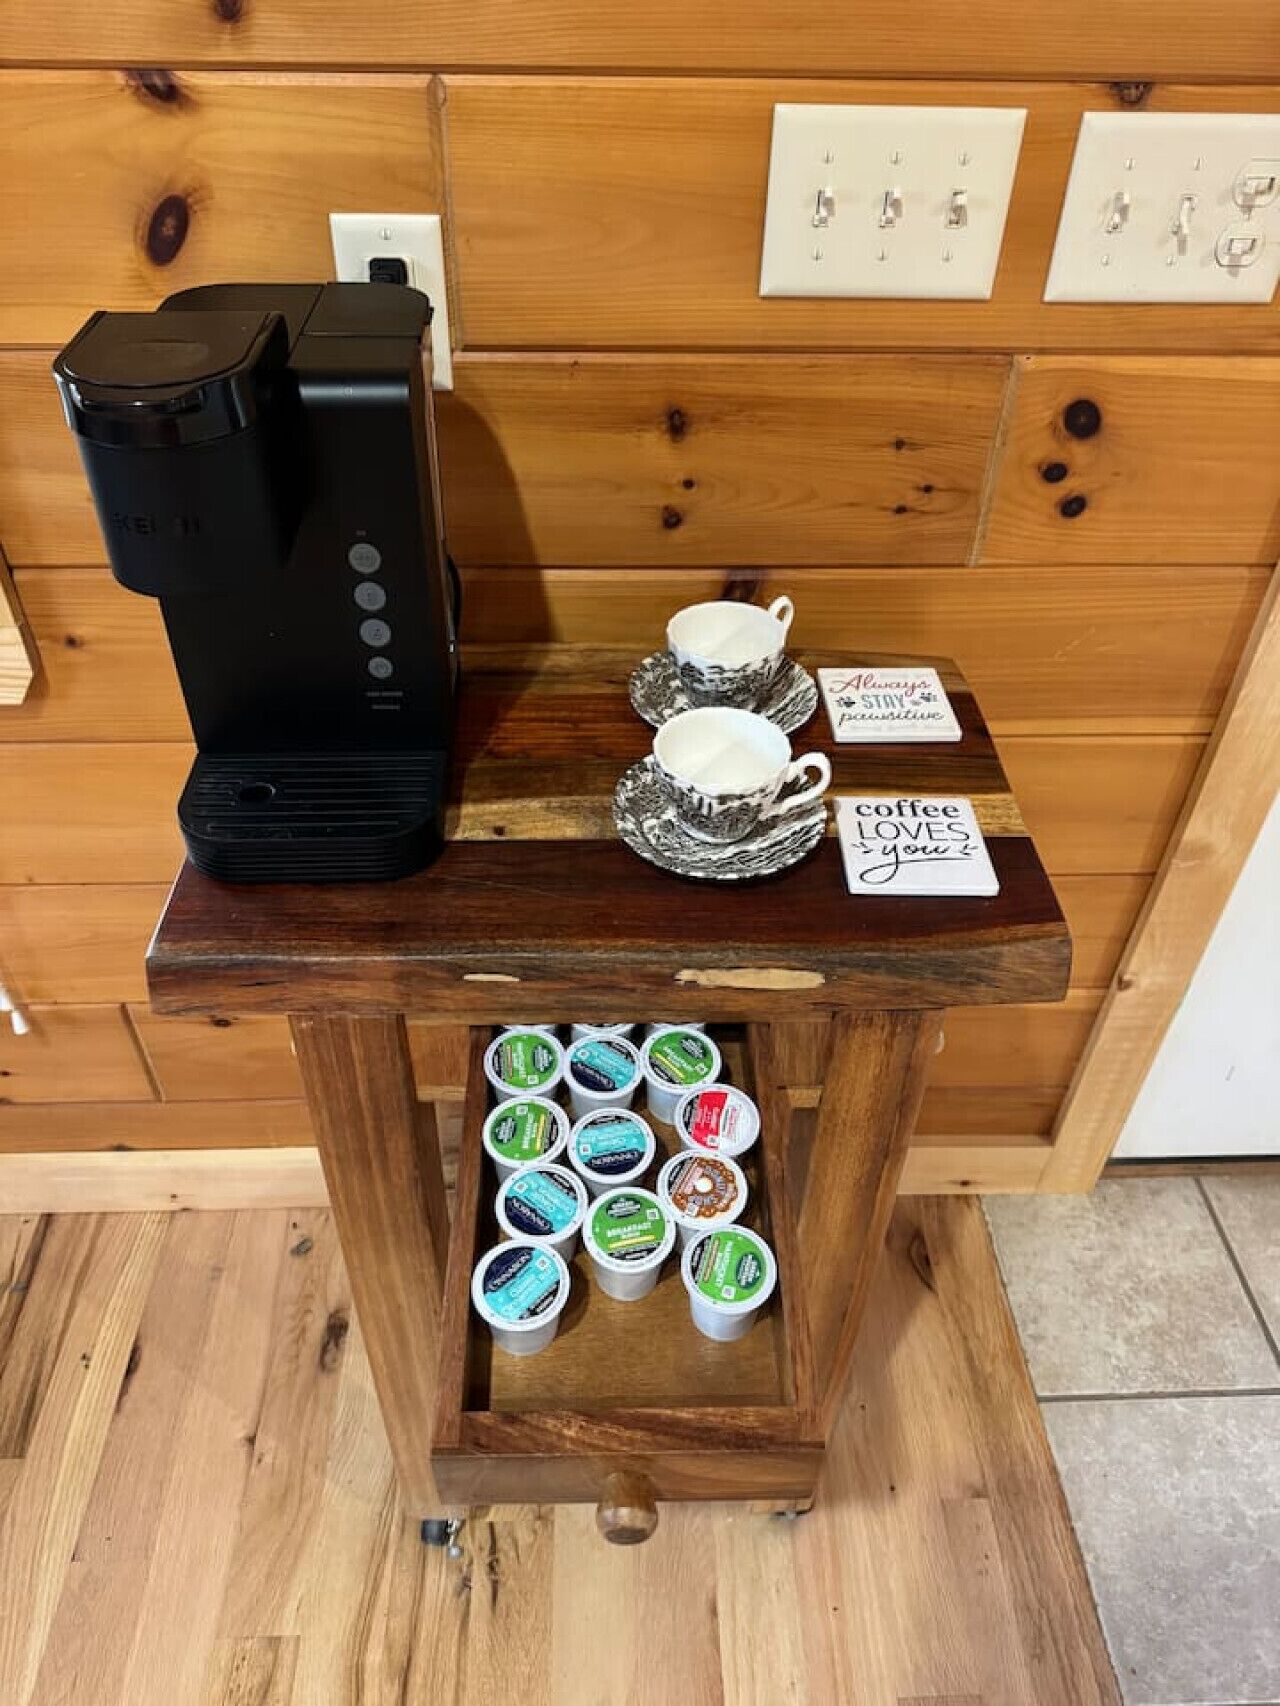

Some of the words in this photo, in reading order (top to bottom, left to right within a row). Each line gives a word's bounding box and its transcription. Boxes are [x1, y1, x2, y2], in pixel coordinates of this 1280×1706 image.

[829, 673, 931, 697] Always
[861, 694, 905, 709] STAY
[855, 799, 960, 817] coffee
[857, 820, 970, 841] LOVES
[859, 843, 973, 885] you
